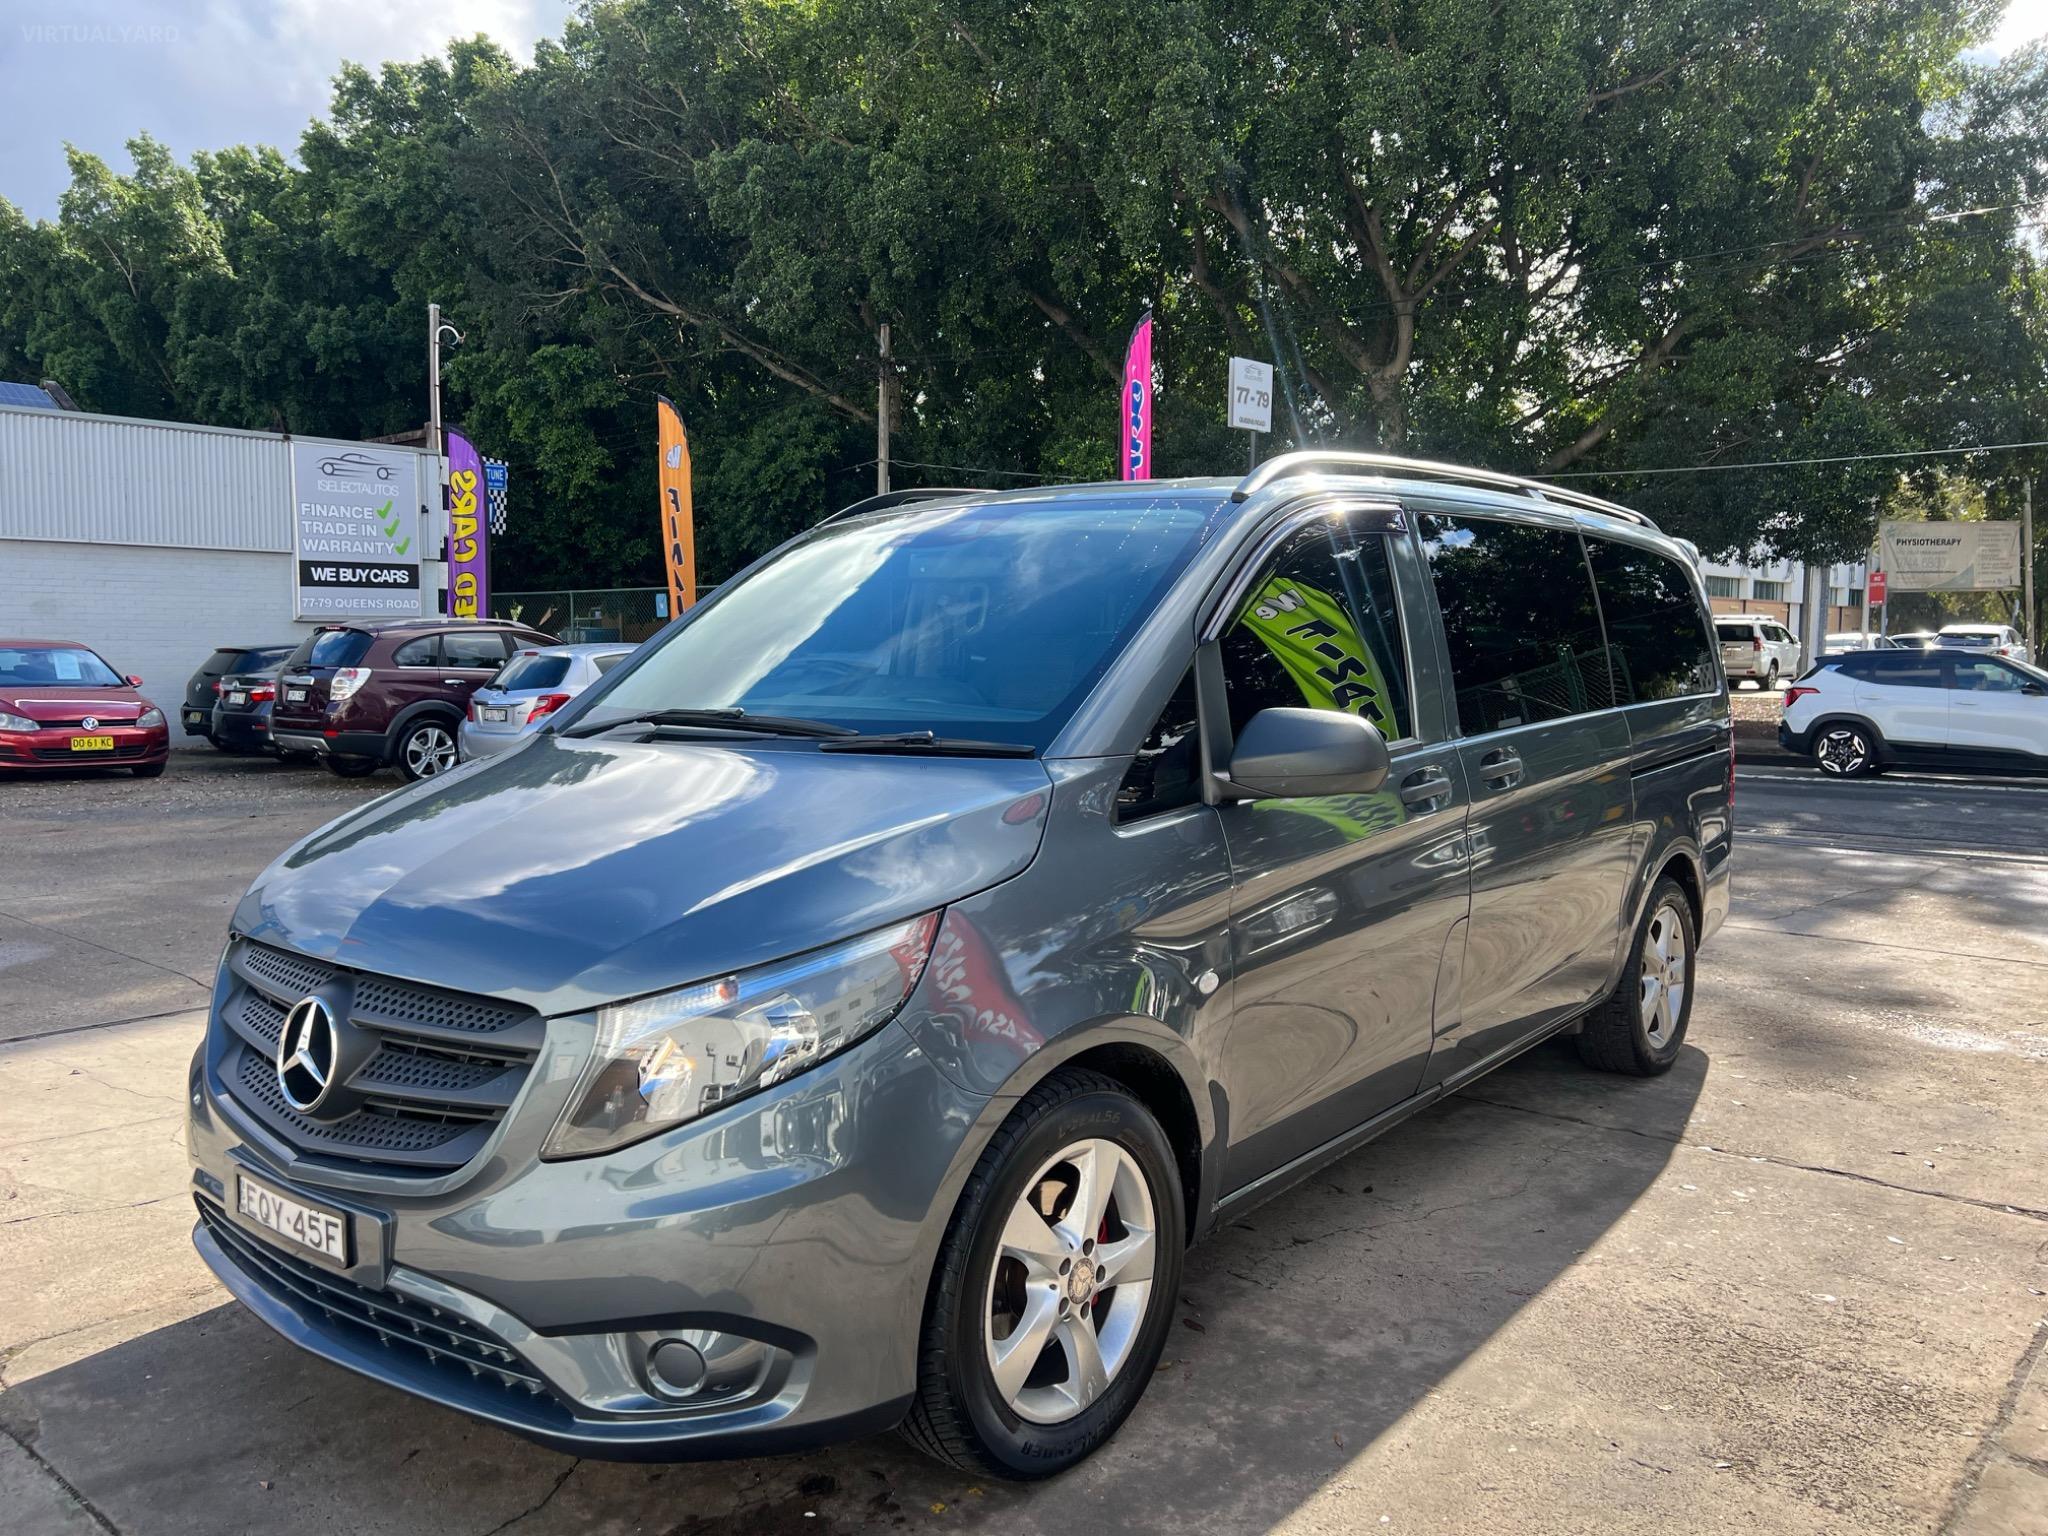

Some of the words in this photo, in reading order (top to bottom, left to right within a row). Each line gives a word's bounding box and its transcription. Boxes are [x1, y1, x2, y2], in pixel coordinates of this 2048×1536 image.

[486, 468, 504, 480] TUNE
[301, 502, 374, 520] FINANCE
[302, 520, 358, 536] TRADE
[360, 523, 378, 538] IN
[302, 538, 395, 555] WARRANTY
[1896, 538, 1962, 547] PHYSIOTHERAPY
[310, 566, 336, 582] WE
[339, 567, 369, 583] BUY
[370, 568, 410, 584] CARS
[302, 598, 332, 609] 77-79
[335, 598, 384, 610] QUEENS
[386, 599, 419, 610] ROAD
